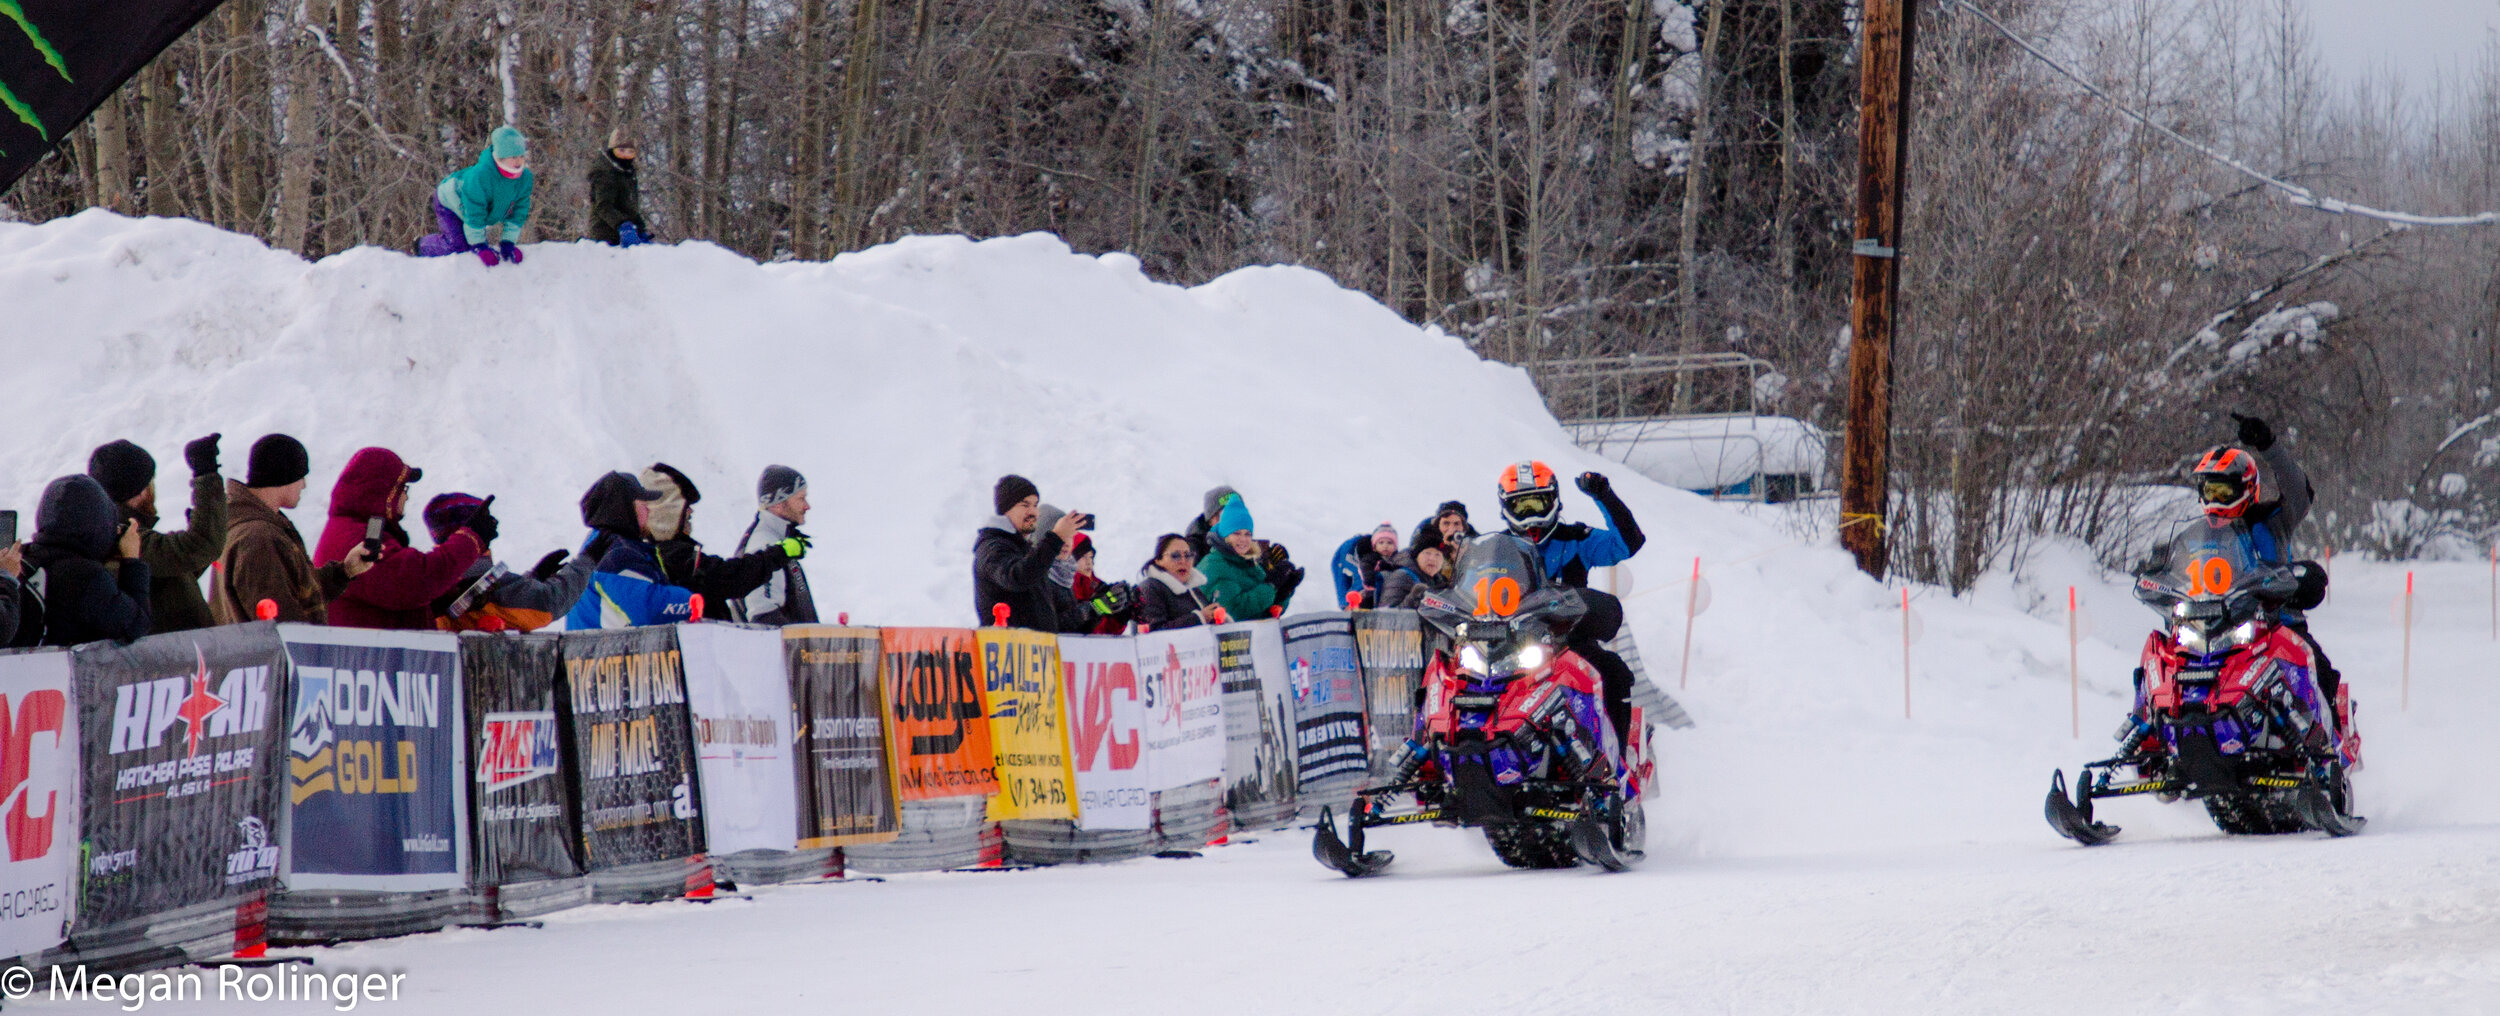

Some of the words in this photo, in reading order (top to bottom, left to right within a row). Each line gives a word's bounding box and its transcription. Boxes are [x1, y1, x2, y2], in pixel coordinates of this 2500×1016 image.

[1473, 577, 1520, 617] 10
[2186, 557, 2232, 597] 10
[1424, 597, 1456, 613] AMSOIL
[334, 669, 439, 728] DONLIN
[177, 754, 212, 779] PASS
[337, 740, 417, 794] GOLD
[166, 779, 212, 799] ALASKA
